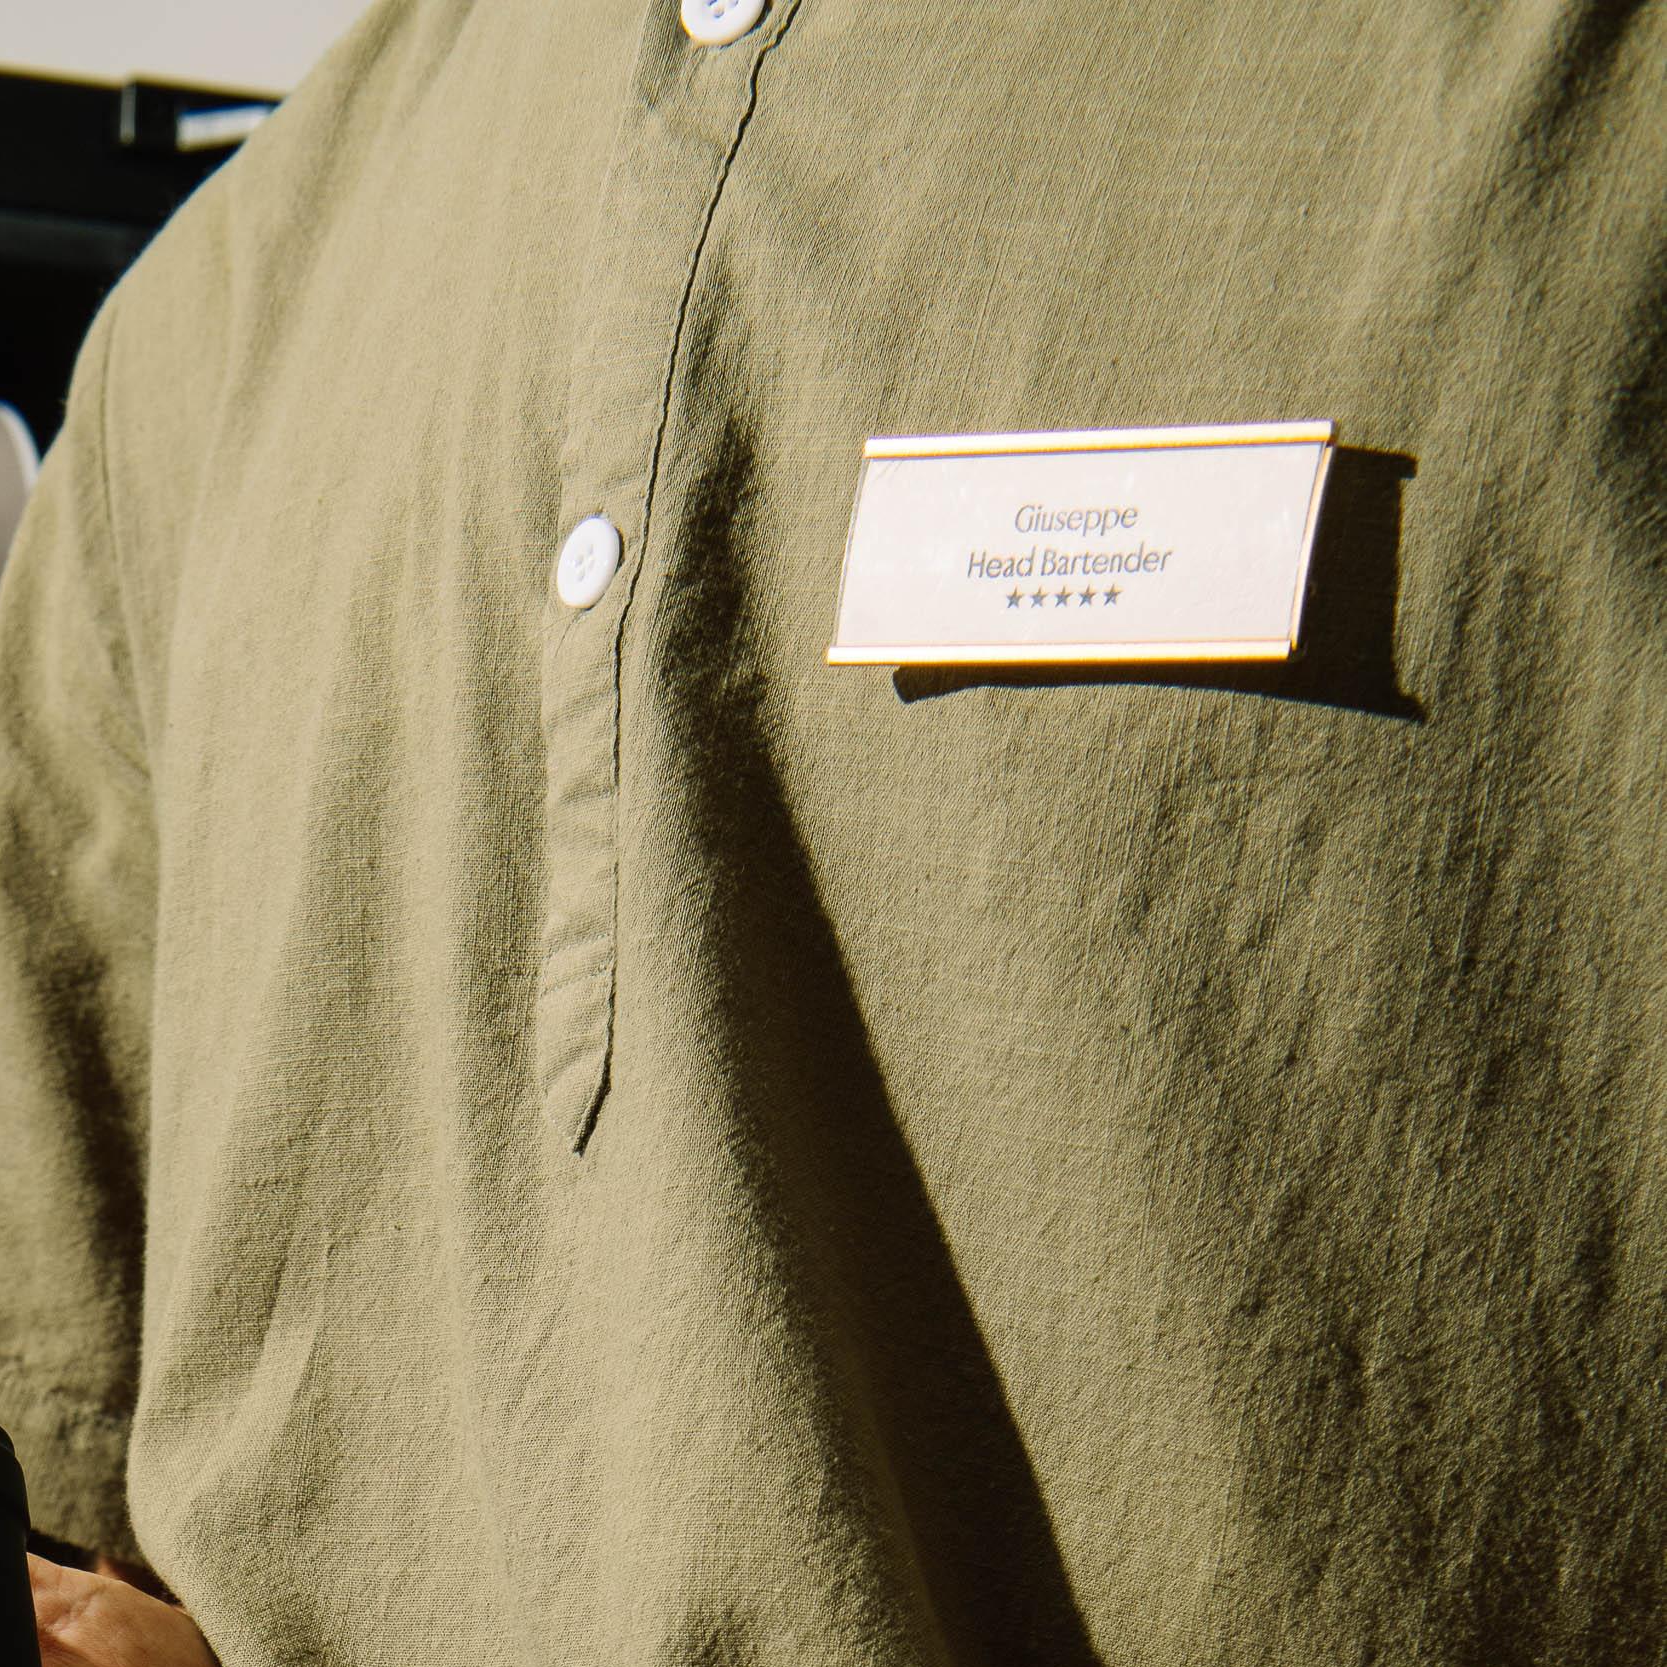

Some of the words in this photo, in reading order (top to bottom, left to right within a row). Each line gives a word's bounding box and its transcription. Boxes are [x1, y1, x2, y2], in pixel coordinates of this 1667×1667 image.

[1014, 504, 1139, 536] Giuseppe
[966, 545, 1034, 578] Head
[1040, 541, 1173, 577] Bartender
